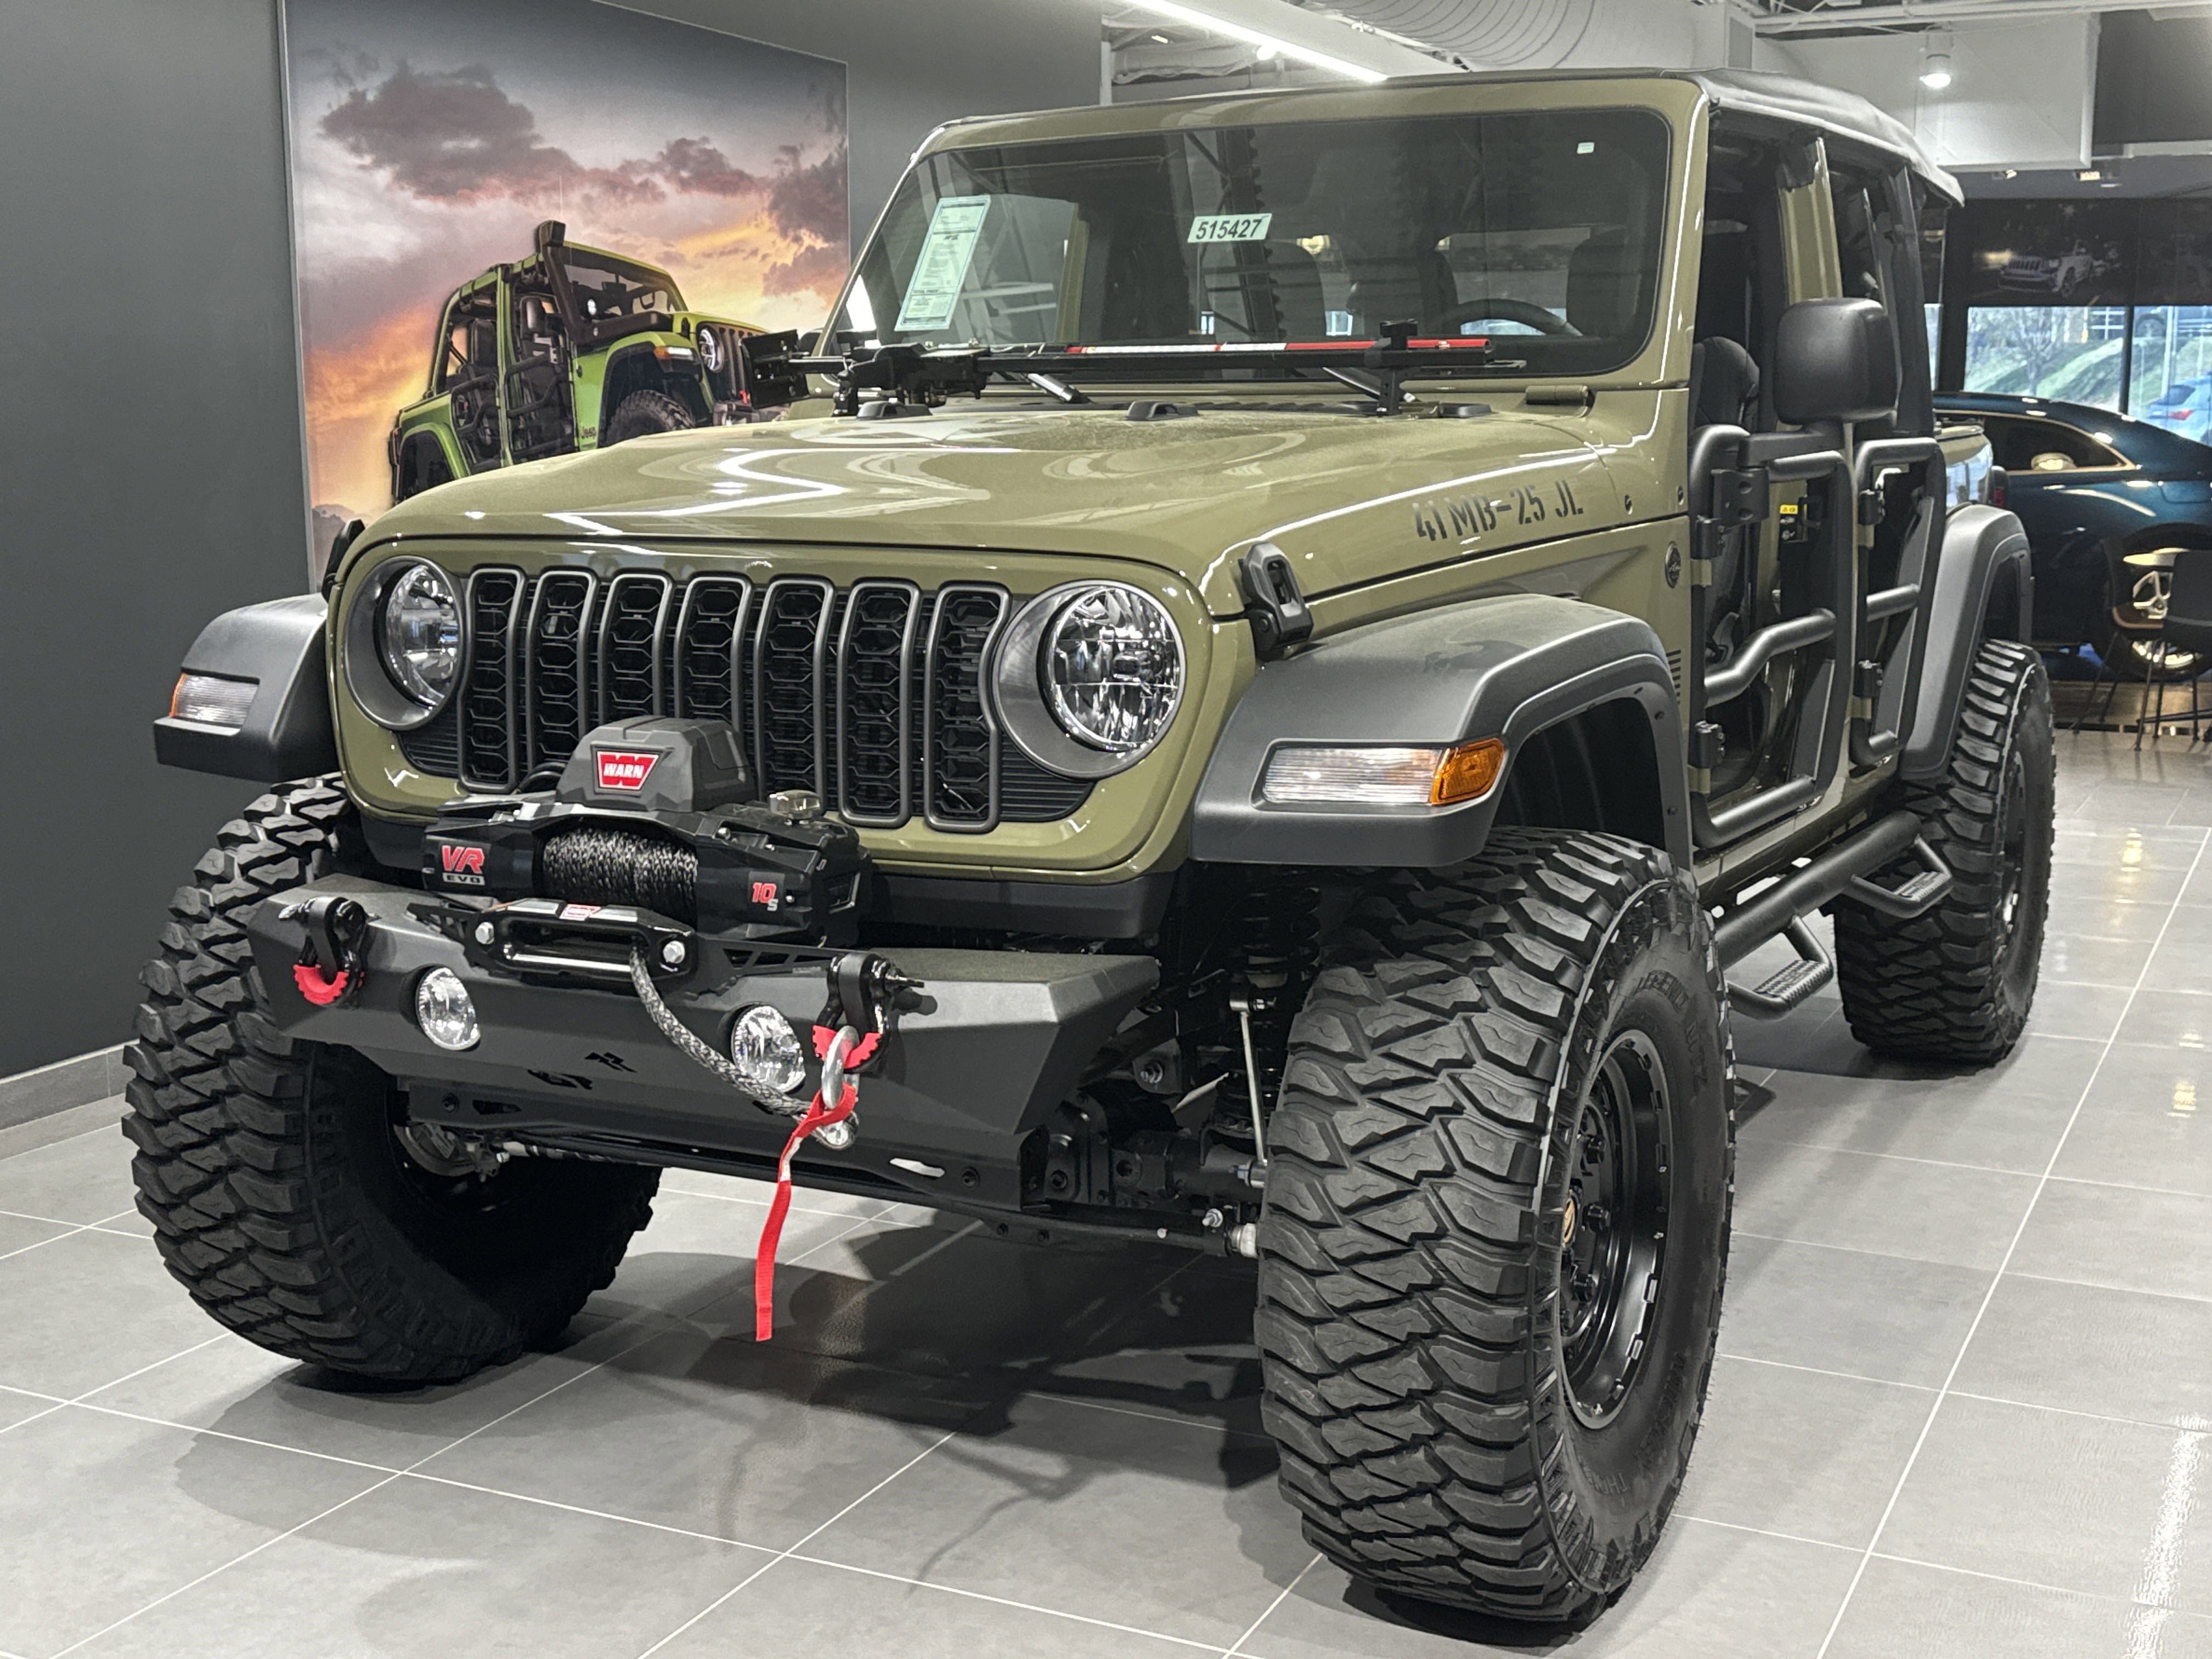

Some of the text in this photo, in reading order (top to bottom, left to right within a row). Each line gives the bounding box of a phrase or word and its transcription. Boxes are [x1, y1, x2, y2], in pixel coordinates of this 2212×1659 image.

[1195, 218, 1262, 240] 515427
[1555, 480, 1584, 517] JL
[603, 763, 645, 779] WARN
[442, 845, 485, 874] VR
[447, 875, 481, 883] EVO
